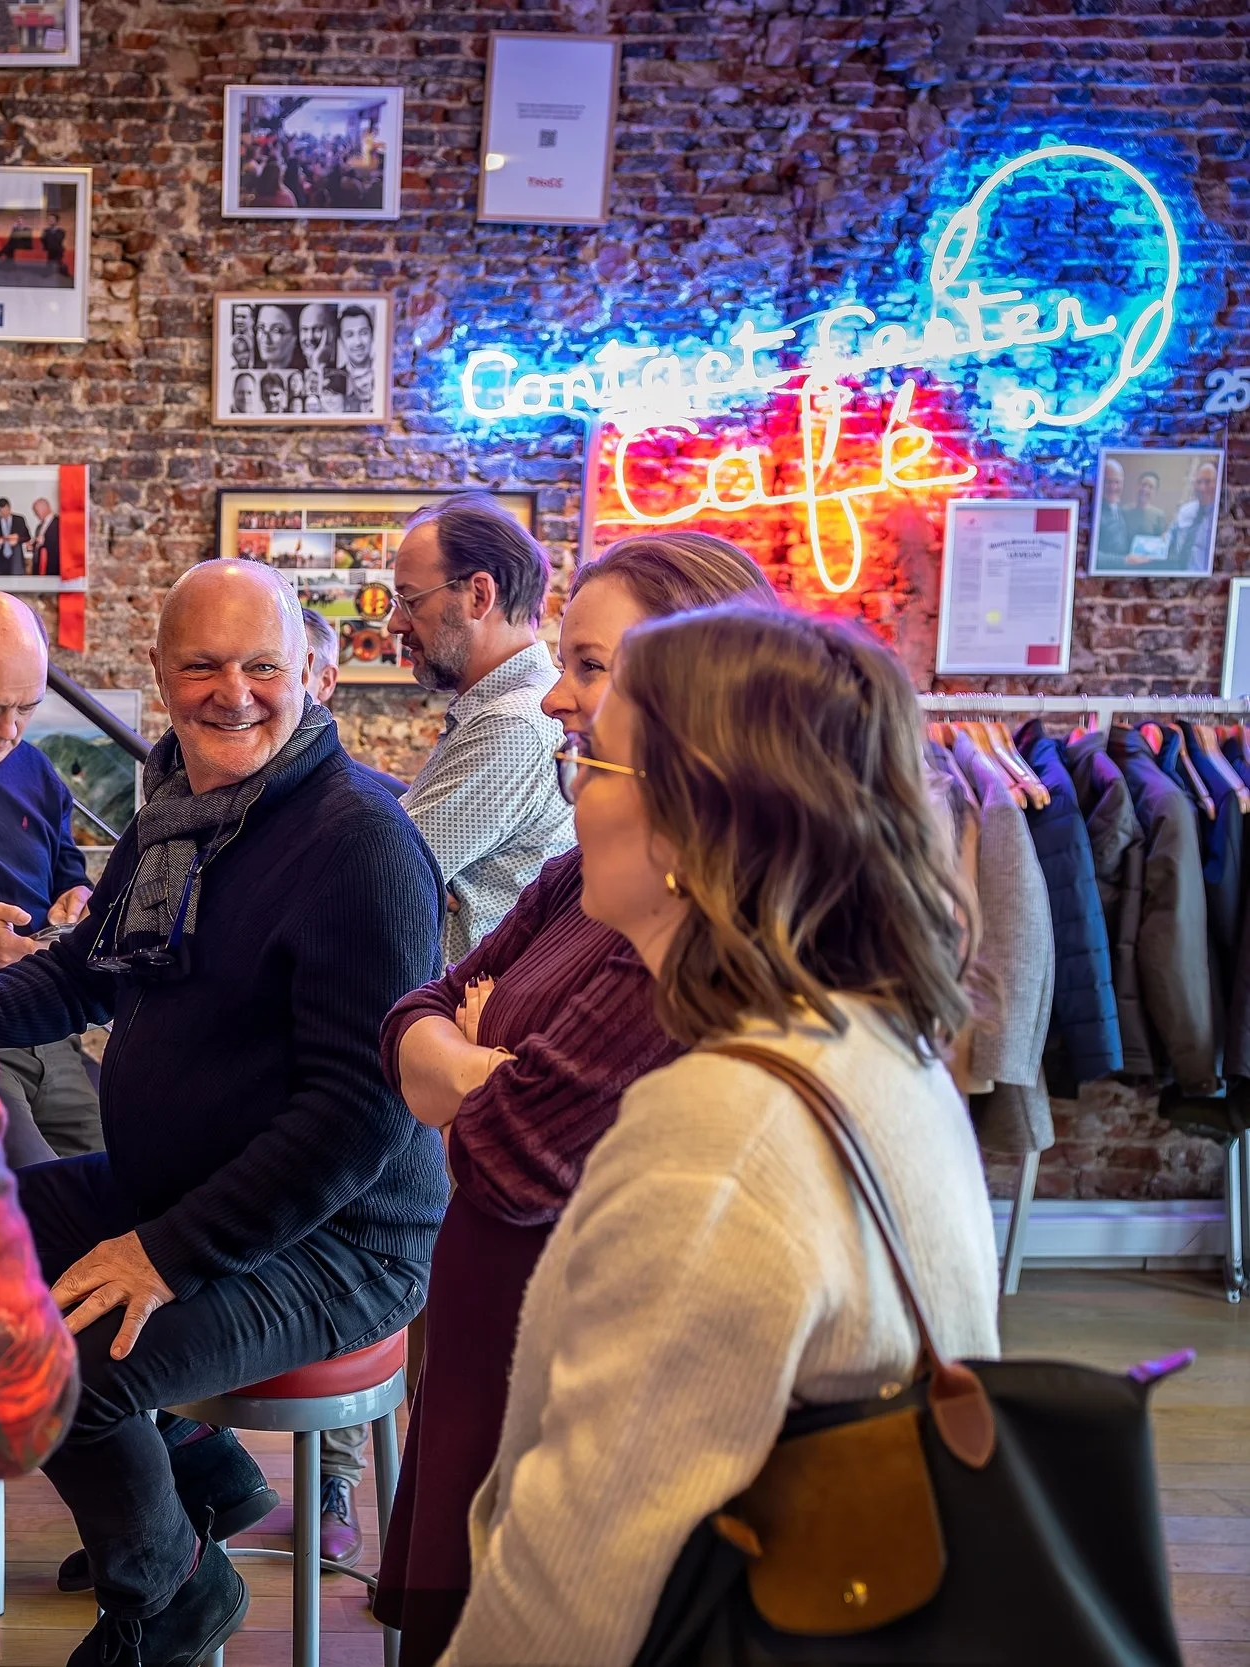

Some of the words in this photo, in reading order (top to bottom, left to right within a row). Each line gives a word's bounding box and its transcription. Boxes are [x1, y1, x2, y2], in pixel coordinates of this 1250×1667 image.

[462, 322, 794, 418] Contact
[818, 285, 1116, 375] Center
[596, 378, 977, 593] Café
